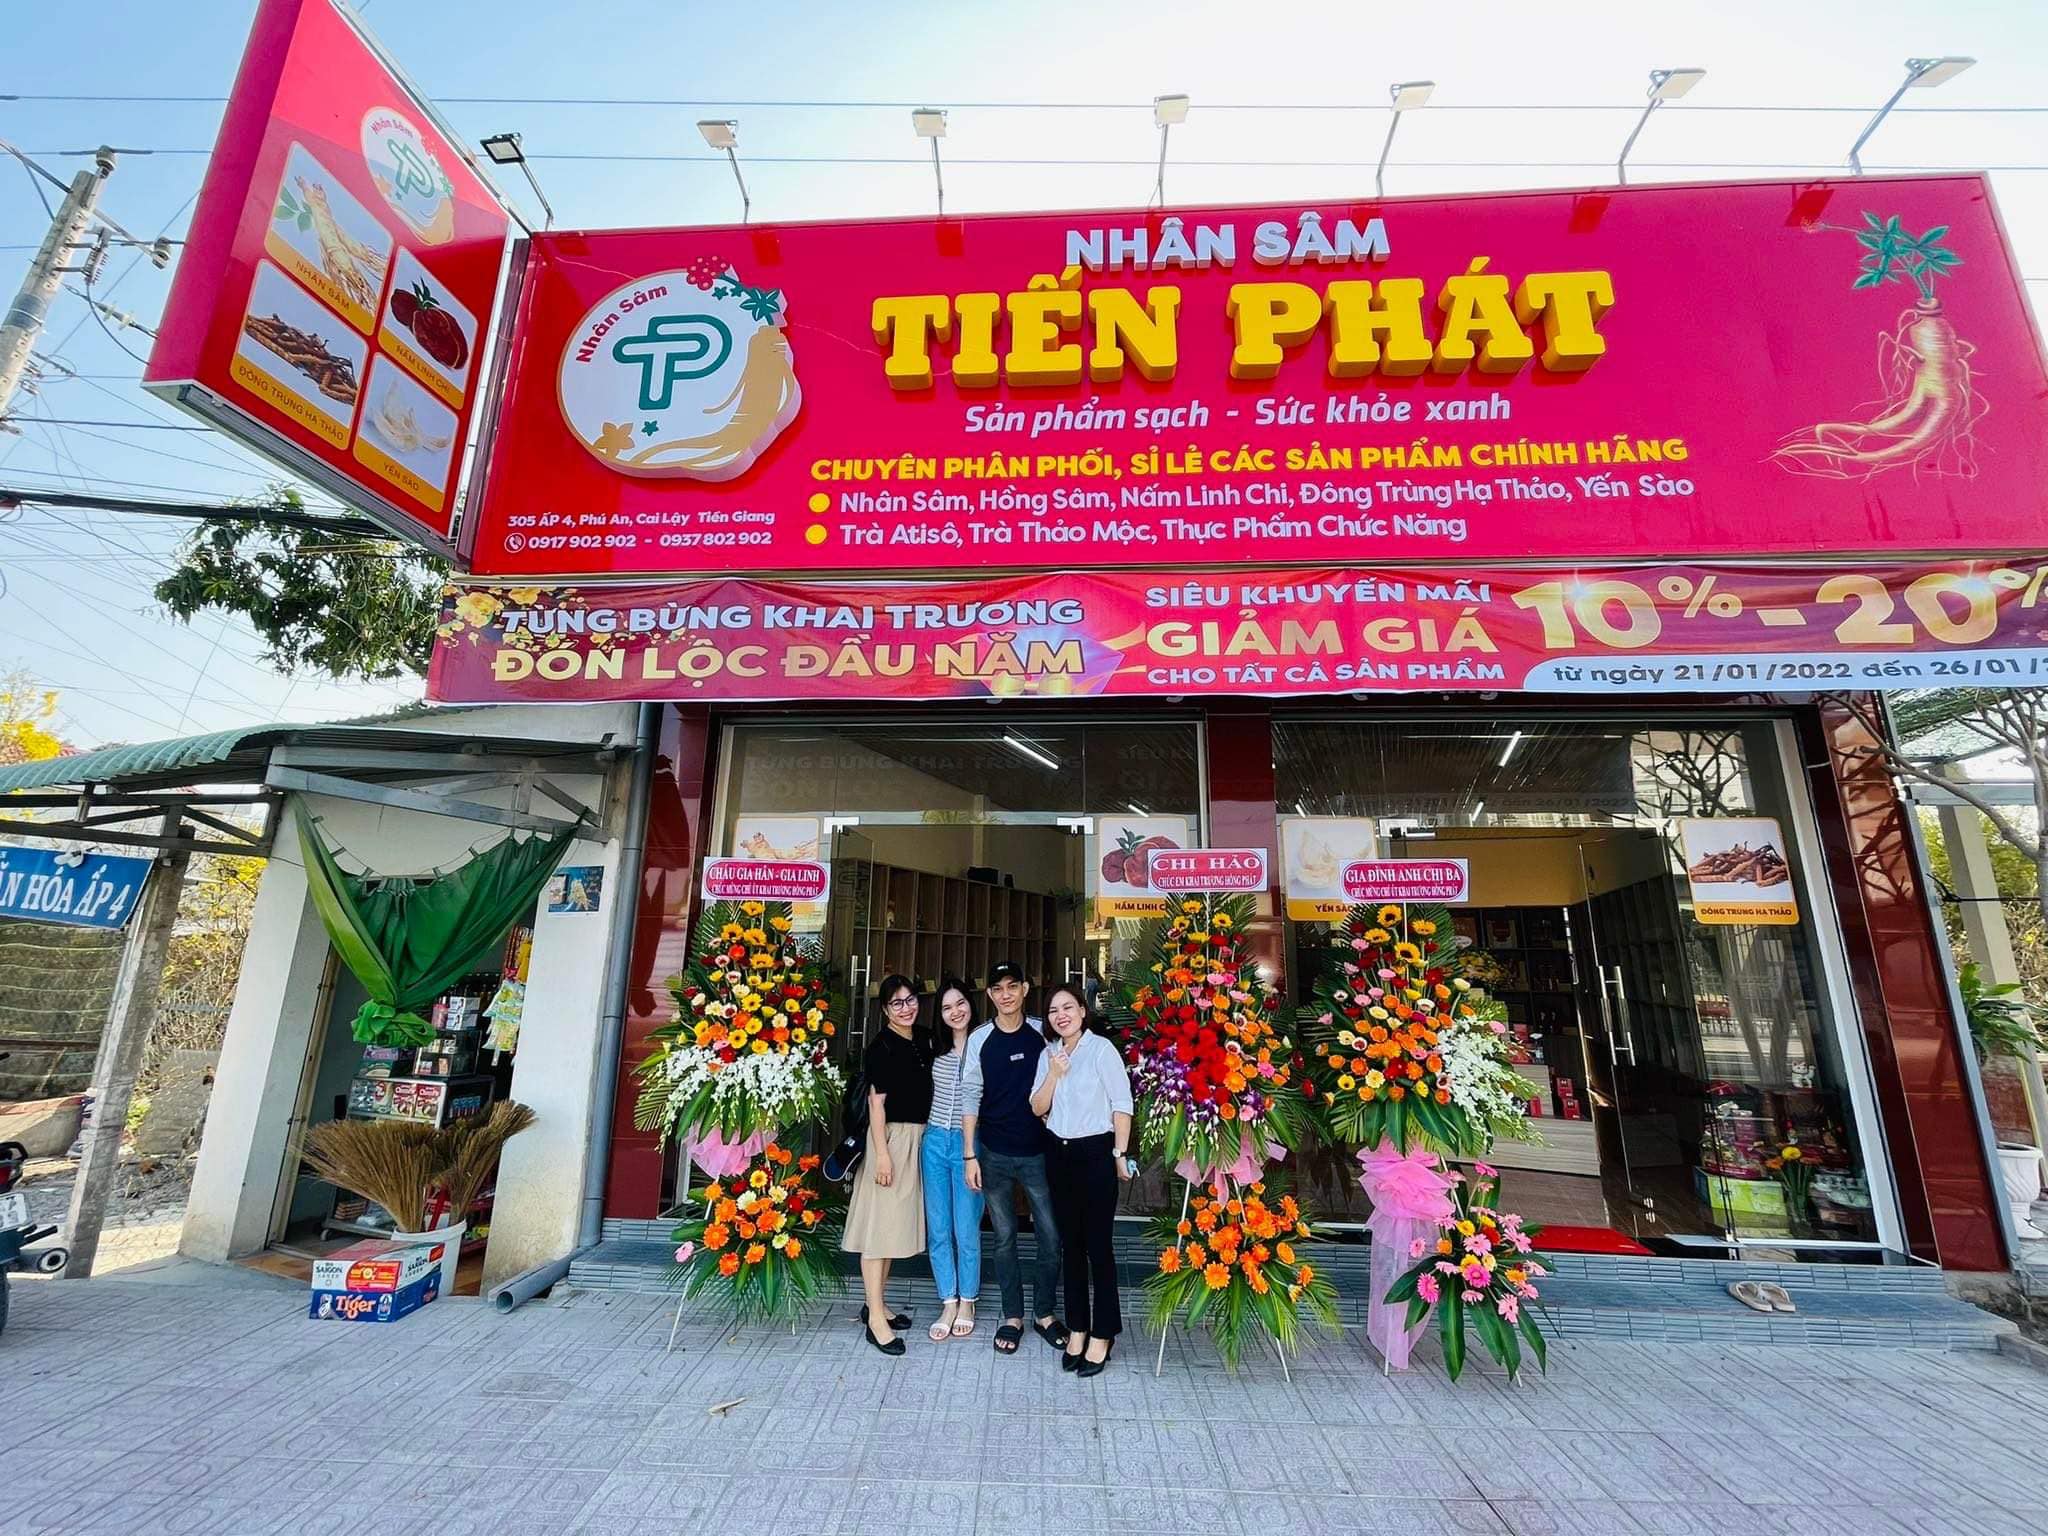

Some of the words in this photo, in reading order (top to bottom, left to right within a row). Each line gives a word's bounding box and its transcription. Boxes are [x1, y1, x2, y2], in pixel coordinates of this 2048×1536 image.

[1066, 216, 1236, 272] NHÂN
[1252, 211, 1390, 265] SÂM
[295, 260, 327, 292] NHÂN
[576, 312, 620, 363] Nhân
[619, 285, 668, 313] Sâm
[872, 265, 1181, 390] TIẾN
[1226, 256, 1615, 379] PHÁT
[239, 364, 269, 392] ĐÔNG
[965, 402, 1024, 432] Sản
[1030, 396, 1125, 438] phẩm
[1134, 400, 1209, 434] sạch
[1255, 396, 1315, 425] Sức
[1326, 393, 1412, 424] khỏe
[1424, 392, 1511, 421] xanh
[810, 453, 936, 481] CHUYÊN
[943, 451, 1030, 479] PHÂN
[1036, 447, 1122, 480] PHỐI,
[1130, 444, 1160, 475] SỈ
[1167, 444, 1203, 474] LẺ
[1210, 444, 1276, 472] CÁC
[1286, 441, 1352, 470] SẢN
[1360, 436, 1462, 469] PHẨM
[1470, 438, 1578, 466] CHÍNH
[1586, 434, 1689, 463] HÃNG
[840, 491, 907, 513] Nhân
[912, 490, 975, 515] Sâm,
[979, 485, 1048, 516] Hồng
[1052, 487, 1116, 512] Sâm,
[1121, 483, 1181, 508] Nấm
[1186, 484, 1240, 506] Linh
[1245, 482, 1295, 508] Chi,
[1299, 481, 1373, 510] Đông
[1376, 479, 1452, 509] Trùng
[1455, 479, 1493, 506] Hạ
[1495, 476, 1573, 503] Thảo,
[1575, 472, 1630, 498] Yến
[1639, 475, 1695, 496] Sào
[508, 515, 536, 527] 305
[538, 511, 561, 527] ẤP
[561, 514, 577, 528] 4,
[579, 512, 607, 526] Phú
[609, 514, 634, 528] An,
[636, 512, 660, 525] Cai
[662, 512, 690, 527] Lậy
[732, 511, 775, 526] Giang
[840, 523, 884, 545] Trà
[890, 523, 963, 549] Atisô,
[968, 522, 1013, 543] Trà
[1018, 518, 1086, 543] Thảo
[1092, 518, 1158, 545] Mộc,
[1161, 519, 1226, 545] Thực
[1233, 512, 1312, 539] Phẩm
[1317, 514, 1387, 538] Chức
[1394, 513, 1467, 542] Năng
[528, 535, 567, 549] 0917
[569, 535, 602, 549] 902
[604, 535, 637, 548] 902
[660, 534, 700, 547] 0937
[702, 533, 736, 546] 802
[738, 532, 772, 545] 902
[1145, 582, 1231, 609] SIÊU
[1241, 577, 1405, 606] KHUYẾN
[1416, 578, 1493, 603] MÃI
[502, 603, 618, 635] TỪNG
[628, 602, 752, 633] BỪNG
[763, 604, 874, 629] KHAI
[884, 598, 1085, 630] TRƯƠNG
[1510, 574, 1743, 650] 10%
[1145, 608, 1345, 657] GIẢM
[1362, 607, 1501, 654] GIÁ
[491, 639, 626, 682] ĐÓN
[641, 638, 770, 688] LỘC
[780, 634, 917, 678] ĐẦU
[933, 631, 1085, 677] NĂM
[1147, 665, 1216, 686] CHO
[1223, 661, 1278, 684] TẤT
[1284, 660, 1330, 683] CẢ
[1335, 657, 1400, 681] SẢN
[1407, 657, 1506, 681] PHẨM
[1553, 665, 1583, 682] từ
[1591, 664, 1664, 685] ngày
[1862, 659, 1922, 679] đến
[20, 866, 74, 914] HÓA
[72, 864, 114, 918] ẤP
[107, 884, 131, 920] 4
[709, 864, 736, 880] CHÁU
[736, 867, 753, 881] GIA
[780, 868, 797, 882] GIA
[798, 869, 820, 883] LINH
[1345, 870, 1368, 883] GIA
[1399, 868, 1423, 882] ANH
[1423, 868, 1444, 885] CHỊ
[1446, 868, 1461, 881] BA
[335, 1294, 377, 1320] Tiger
